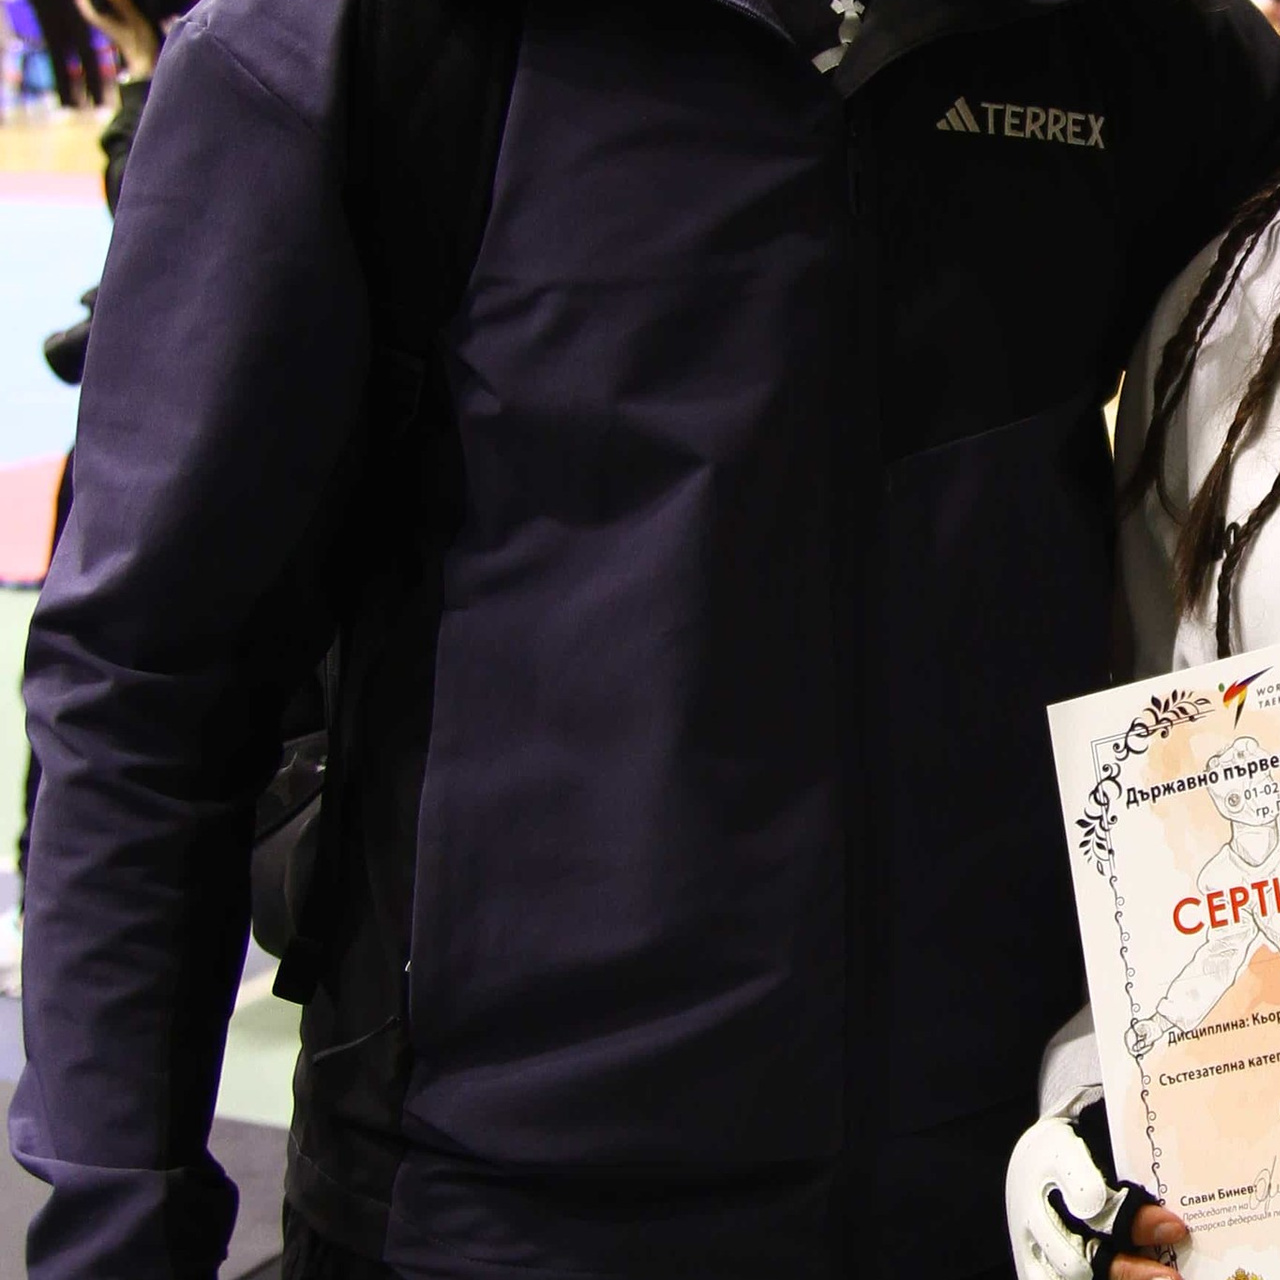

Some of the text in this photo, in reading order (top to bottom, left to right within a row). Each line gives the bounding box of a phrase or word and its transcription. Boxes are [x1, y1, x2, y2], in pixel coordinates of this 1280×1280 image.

[980, 101, 1106, 149] TERREX
[1126, 768, 1220, 809] Държавно
[1255, 806, 1274, 818] гр.
[1167, 1018, 1250, 1047] Дисциплина:
[1158, 1058, 1246, 1087] Състезателна
[1180, 1183, 1258, 1207] Слави Бинев:
[1238, 1203, 1249, 1211] на
